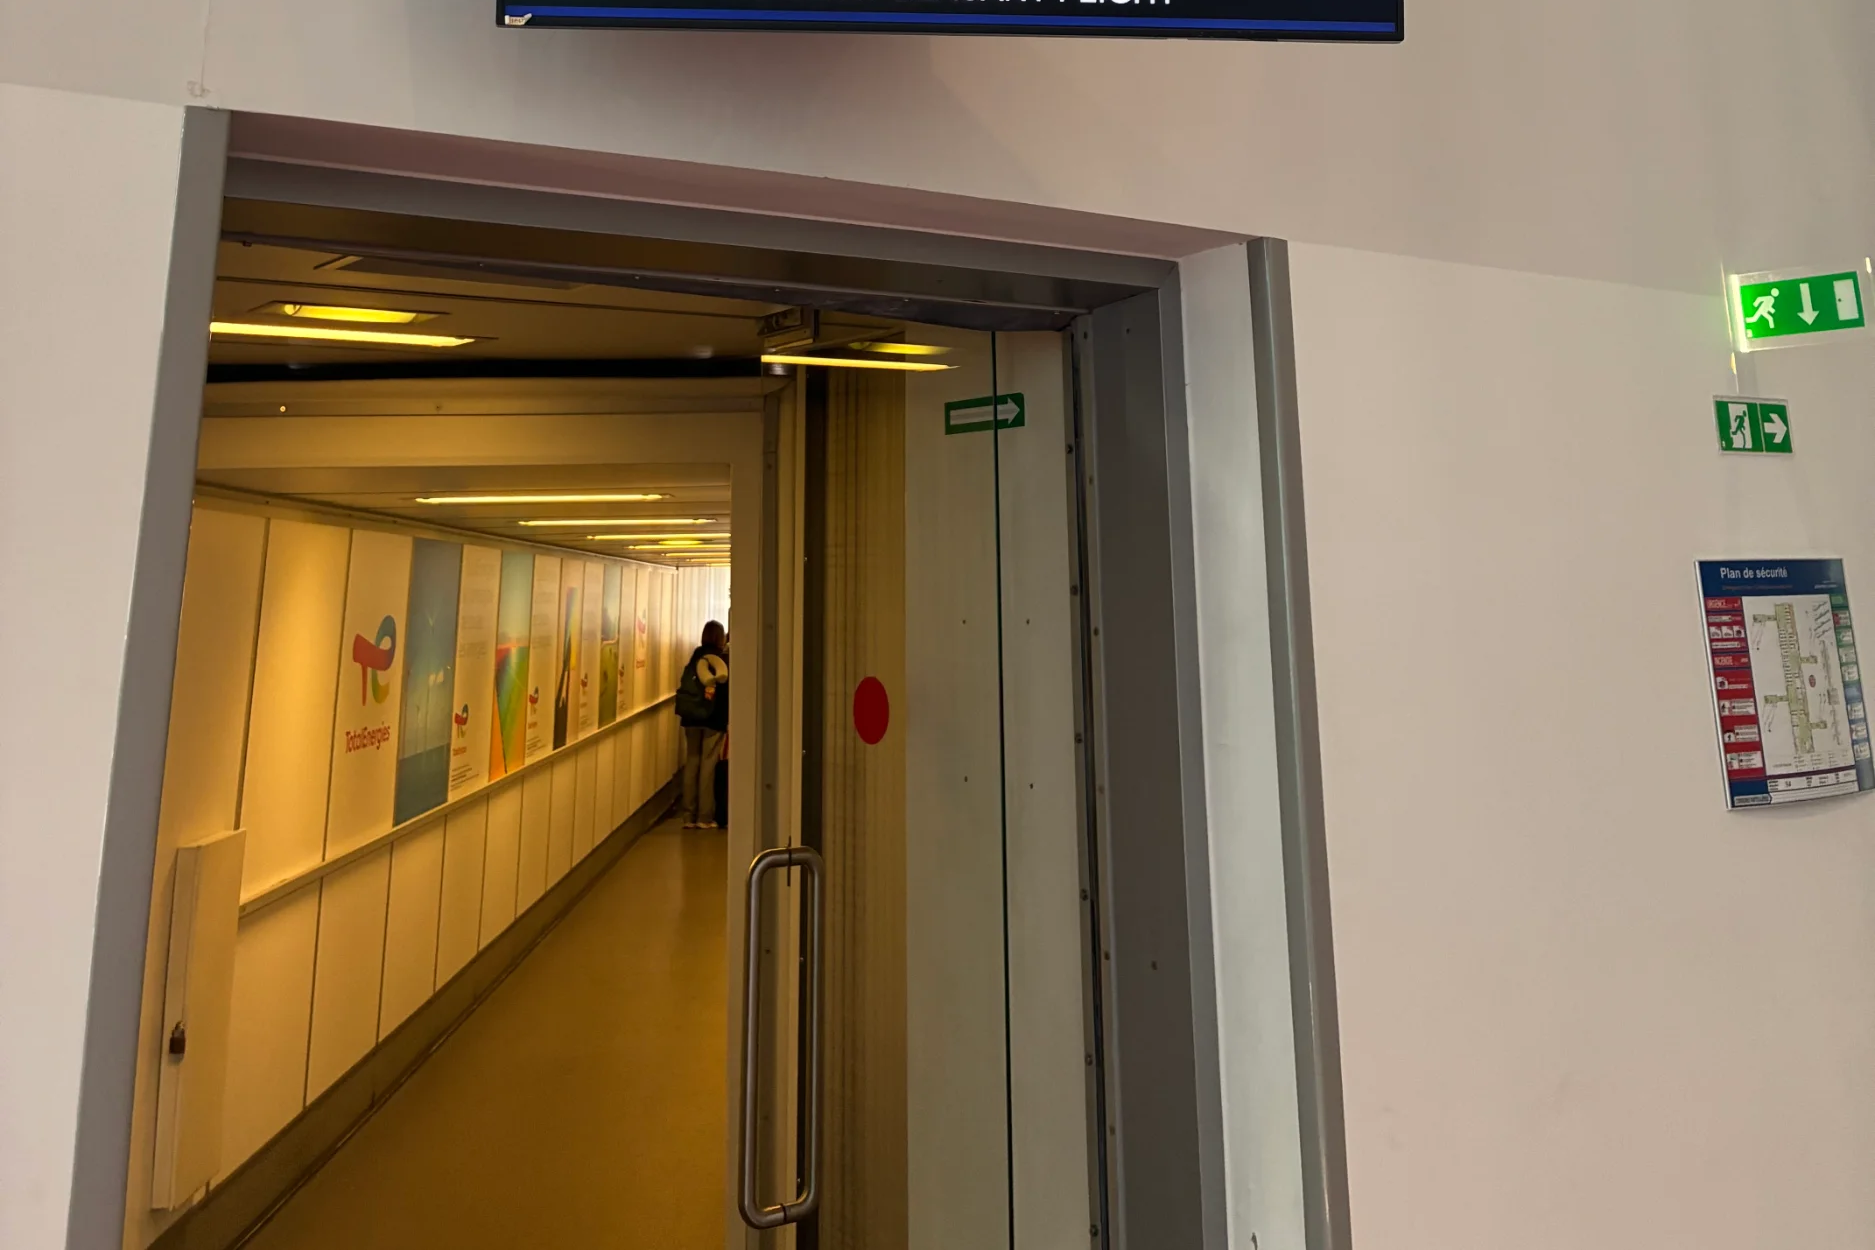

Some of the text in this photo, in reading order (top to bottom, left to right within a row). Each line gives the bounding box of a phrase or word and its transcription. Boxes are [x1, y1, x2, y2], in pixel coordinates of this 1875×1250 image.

[1720, 566, 1788, 578] Plan de sécurité
